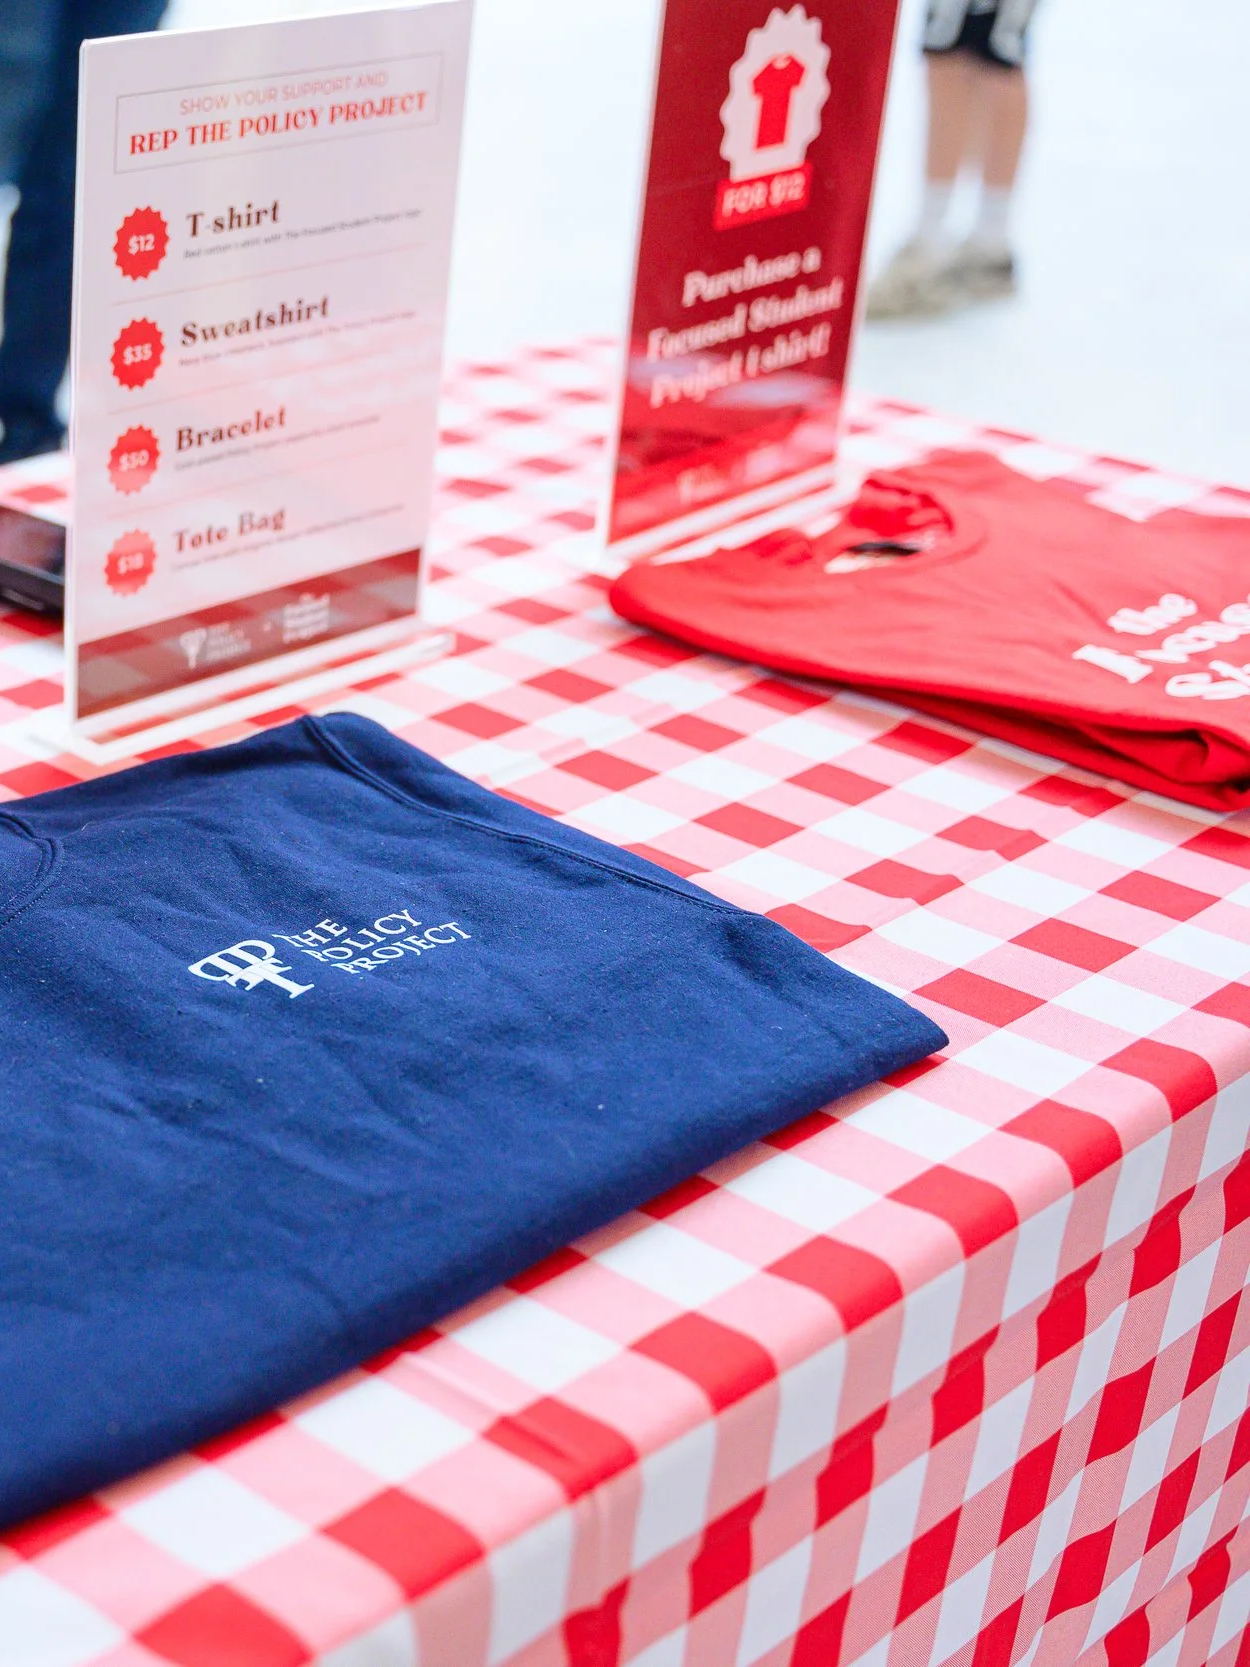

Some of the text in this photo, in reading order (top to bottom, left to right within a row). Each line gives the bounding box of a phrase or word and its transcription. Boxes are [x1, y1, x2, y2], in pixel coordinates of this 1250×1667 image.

[179, 72, 388, 116] SHOW YOUR SUPPORT AND
[129, 91, 428, 157] REP THE POLICY PROJECT
[186, 200, 280, 238] T-shirt
[128, 233, 155, 255] $12
[180, 296, 330, 347] Sweatshirt
[123, 343, 152, 365] $35
[175, 405, 287, 453] Bracelet
[119, 449, 149, 472] $50
[173, 525, 230, 553] Tote
[238, 507, 287, 535] Bag
[300, 909, 423, 962] POLICY
[331, 921, 472, 974] PROJECT
